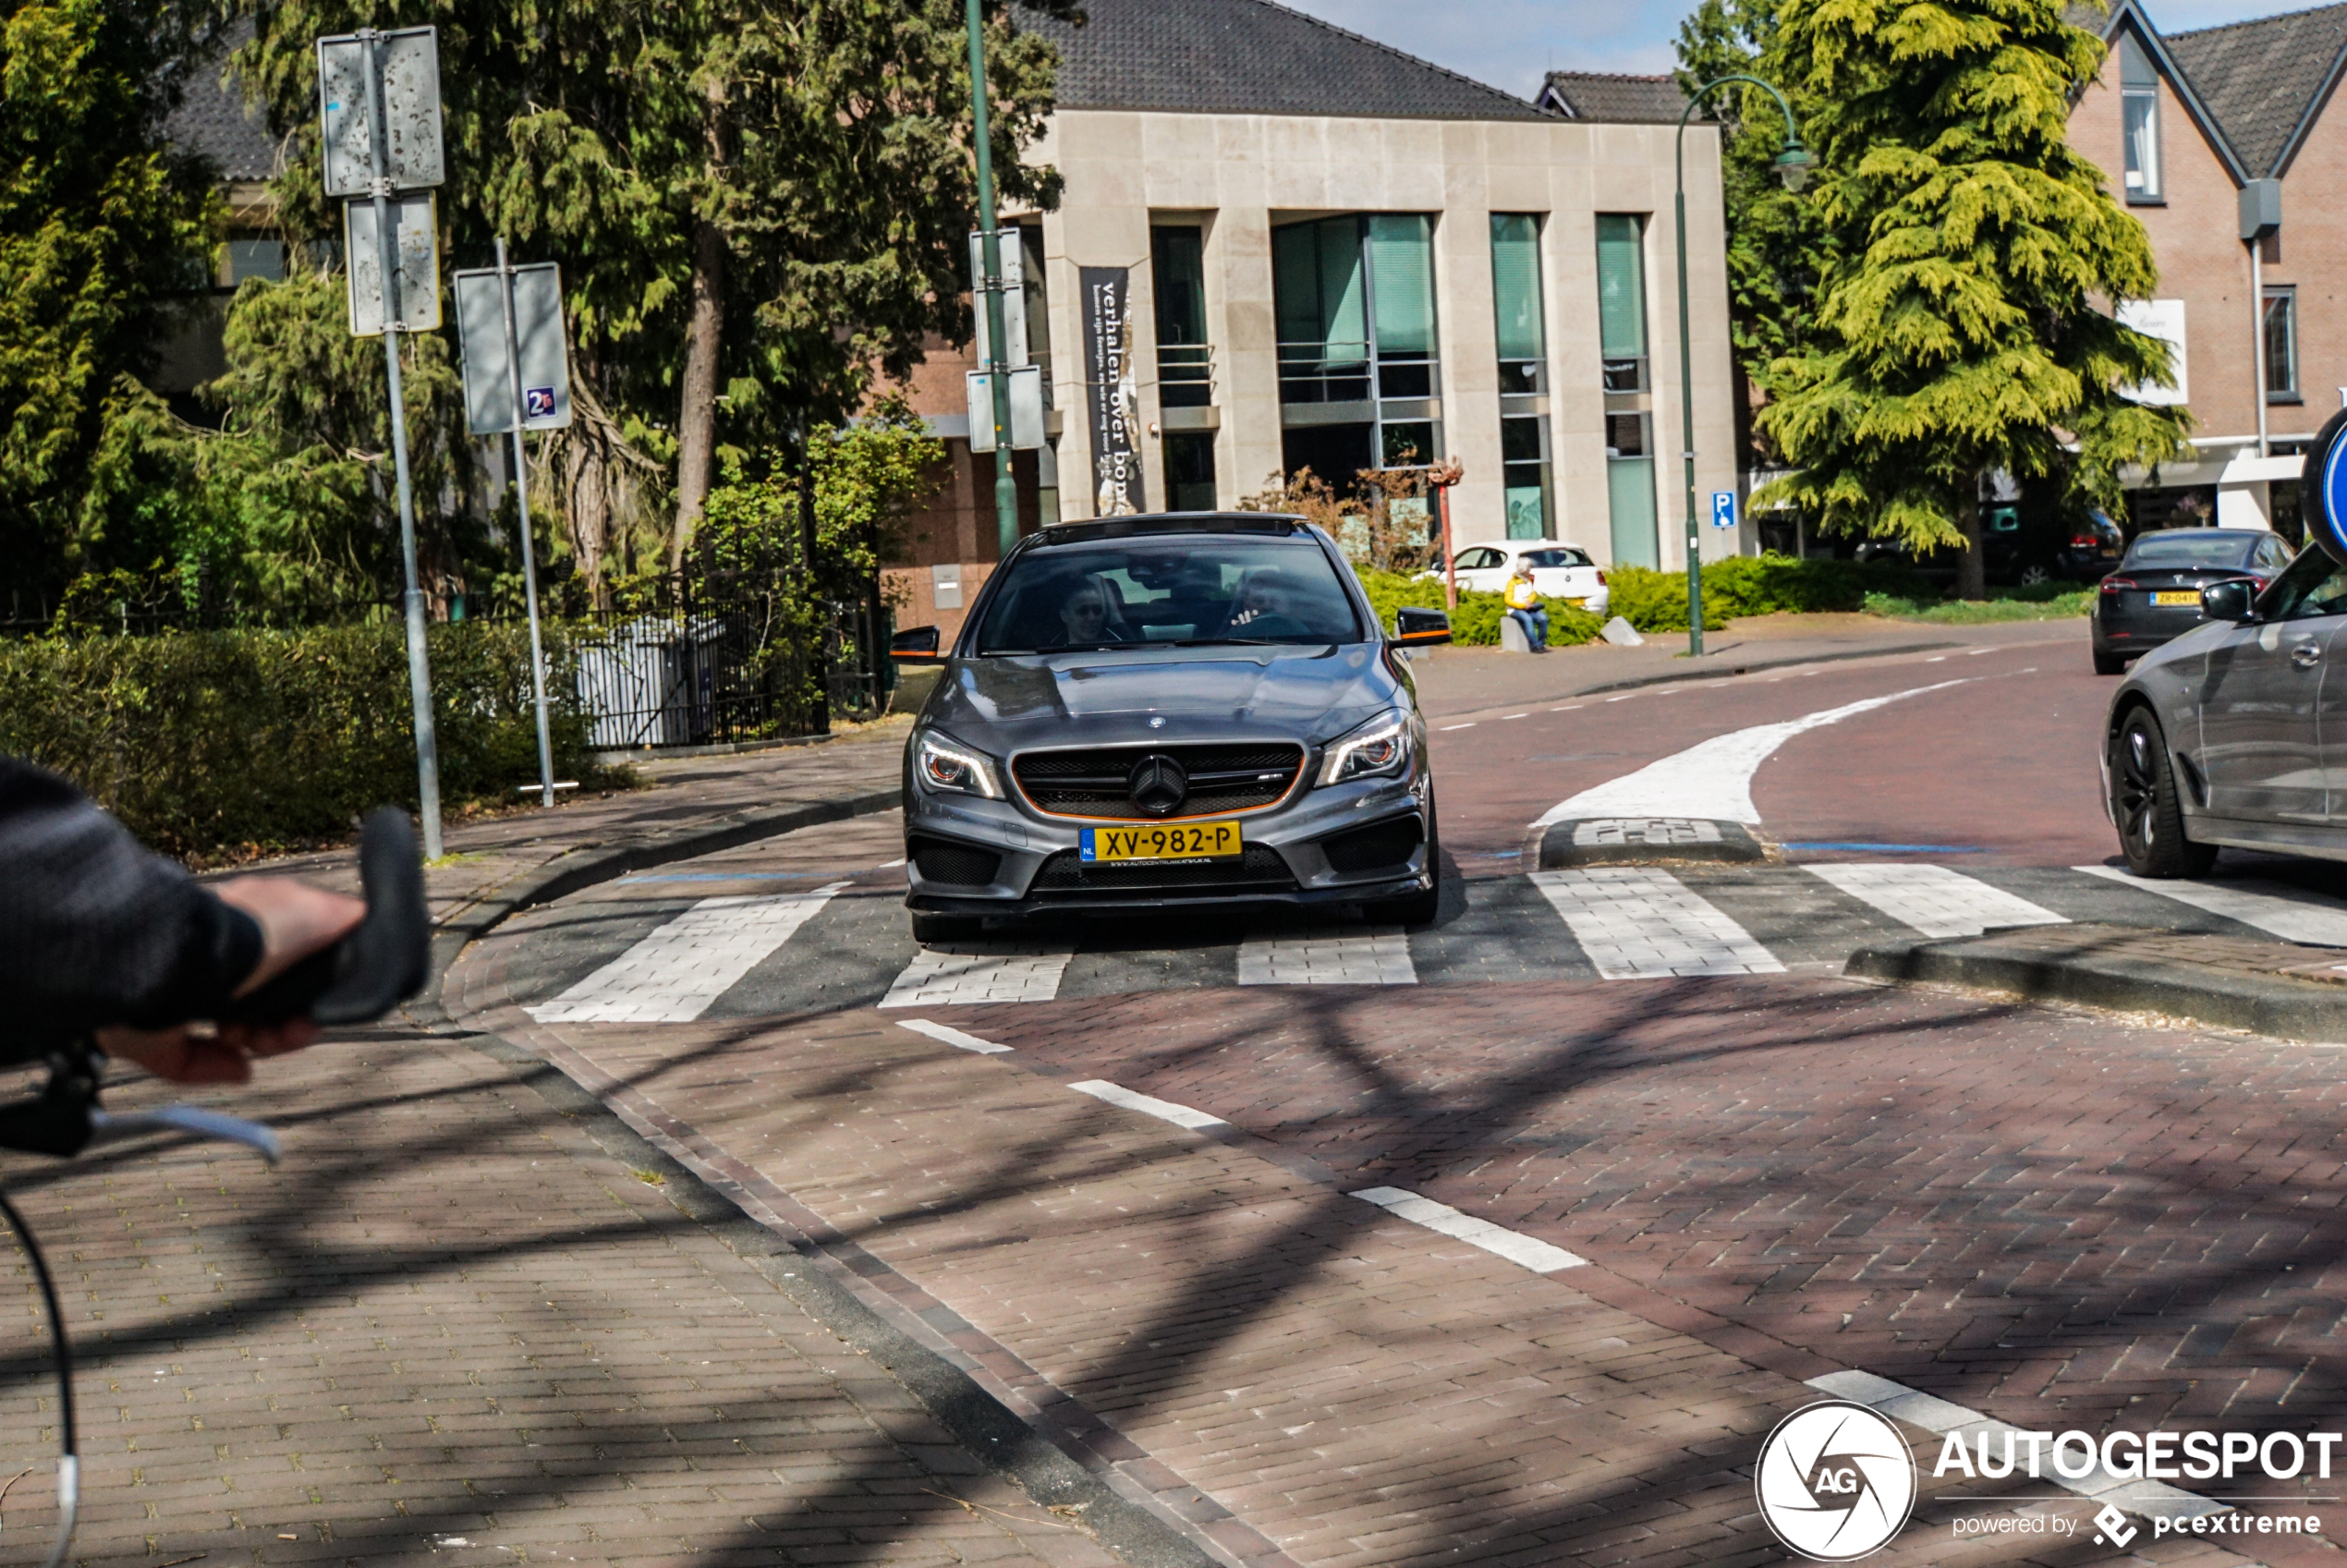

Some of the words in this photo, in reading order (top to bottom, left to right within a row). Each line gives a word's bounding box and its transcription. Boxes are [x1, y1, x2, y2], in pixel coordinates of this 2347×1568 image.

[1092, 284, 1102, 315] bomen
[1093, 317, 1105, 334] zijn
[1102, 281, 1122, 383] verhalen
[1098, 372, 1106, 384] en
[1100, 385, 1108, 401] wie
[1101, 403, 1108, 413] er
[1110, 391, 1125, 444] over
[1100, 413, 1109, 432] oog
[1102, 432, 1111, 453] voor
[1716, 494, 1731, 513] P
[1105, 827, 1231, 856] XV-982-P
[1083, 847, 1094, 856] NL
